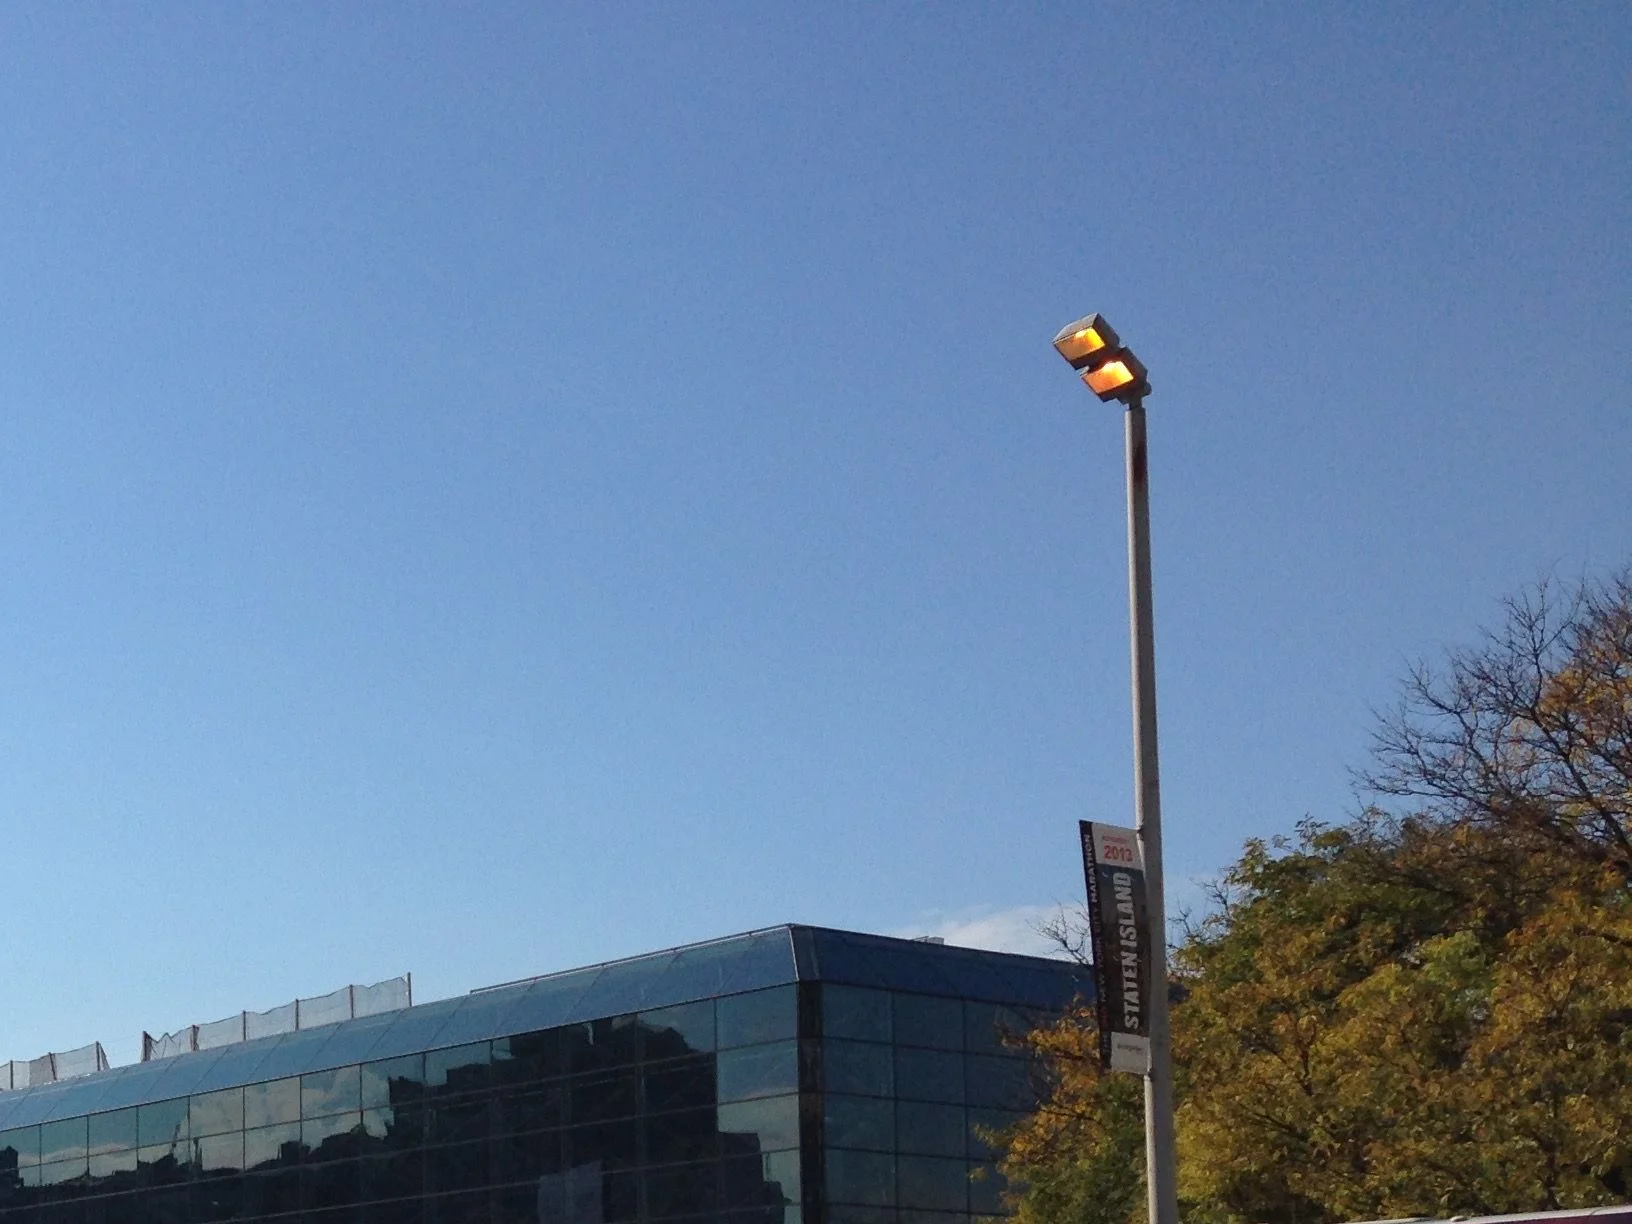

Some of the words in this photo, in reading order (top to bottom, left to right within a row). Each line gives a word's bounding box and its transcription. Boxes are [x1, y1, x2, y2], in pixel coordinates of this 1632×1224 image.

[1083, 834, 1099, 903] MARATHON
[1104, 845, 1133, 862] 2013
[1112, 872, 1137, 947] ISLAND
[1120, 953, 1141, 1030] STATEN
